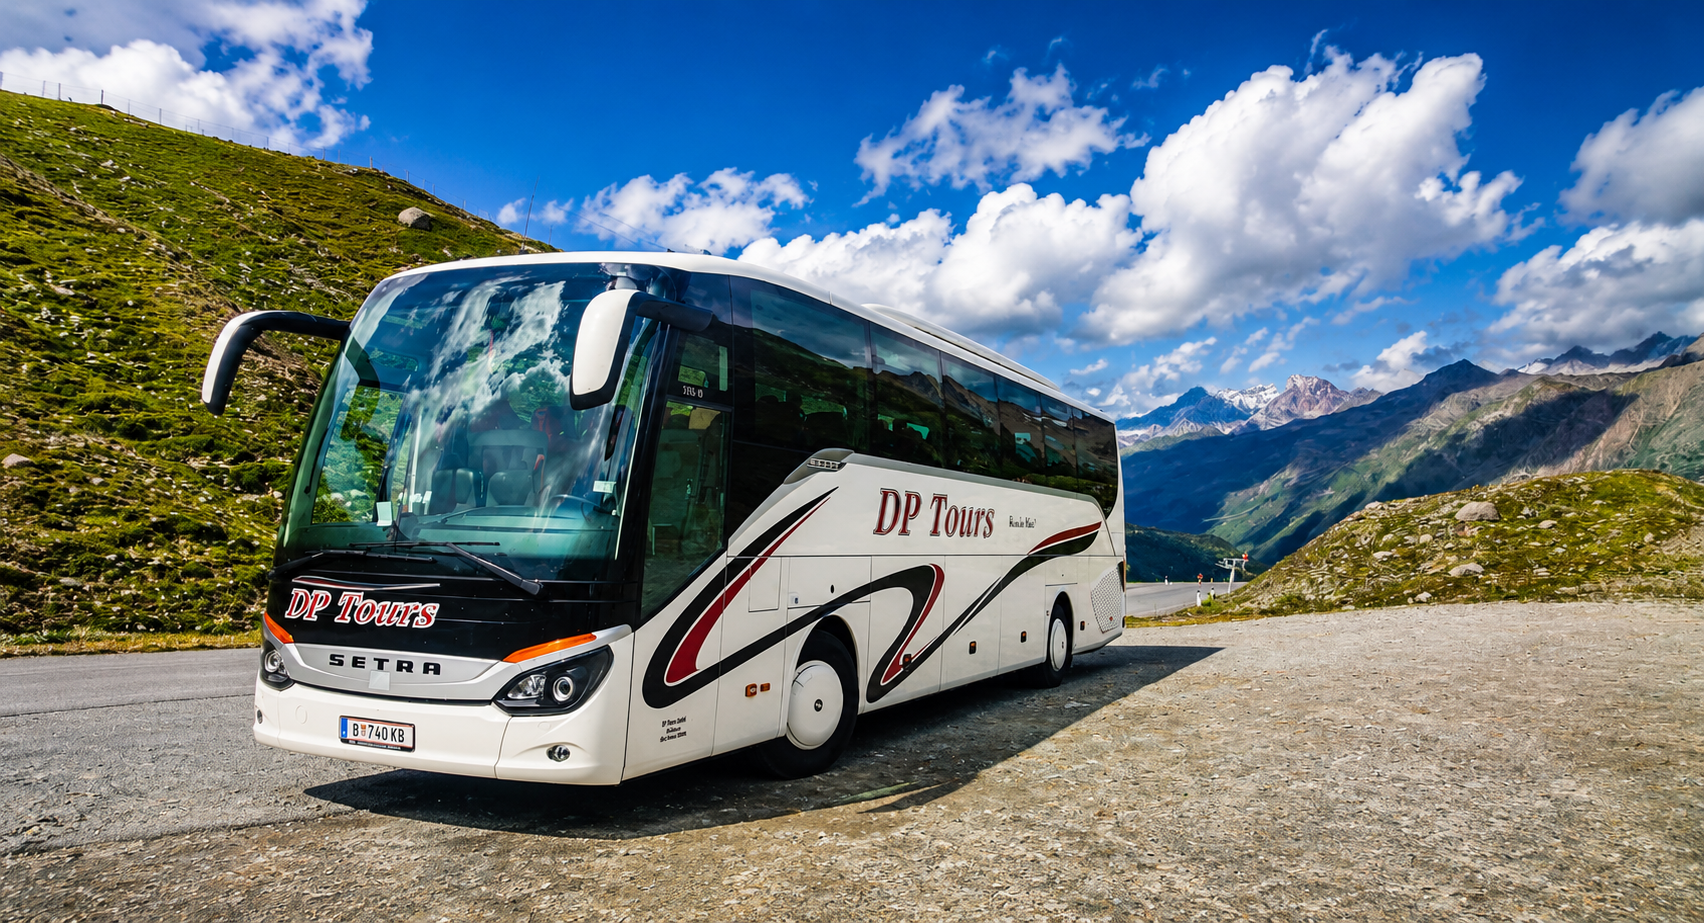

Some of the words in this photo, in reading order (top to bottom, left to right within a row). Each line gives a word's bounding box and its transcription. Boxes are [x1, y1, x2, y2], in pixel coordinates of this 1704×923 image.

[873, 488, 922, 536] DP
[930, 493, 995, 538] Tours
[285, 588, 332, 621] DP
[334, 592, 440, 628] Tours
[329, 654, 441, 675] SETRA
[353, 723, 359, 737] B
